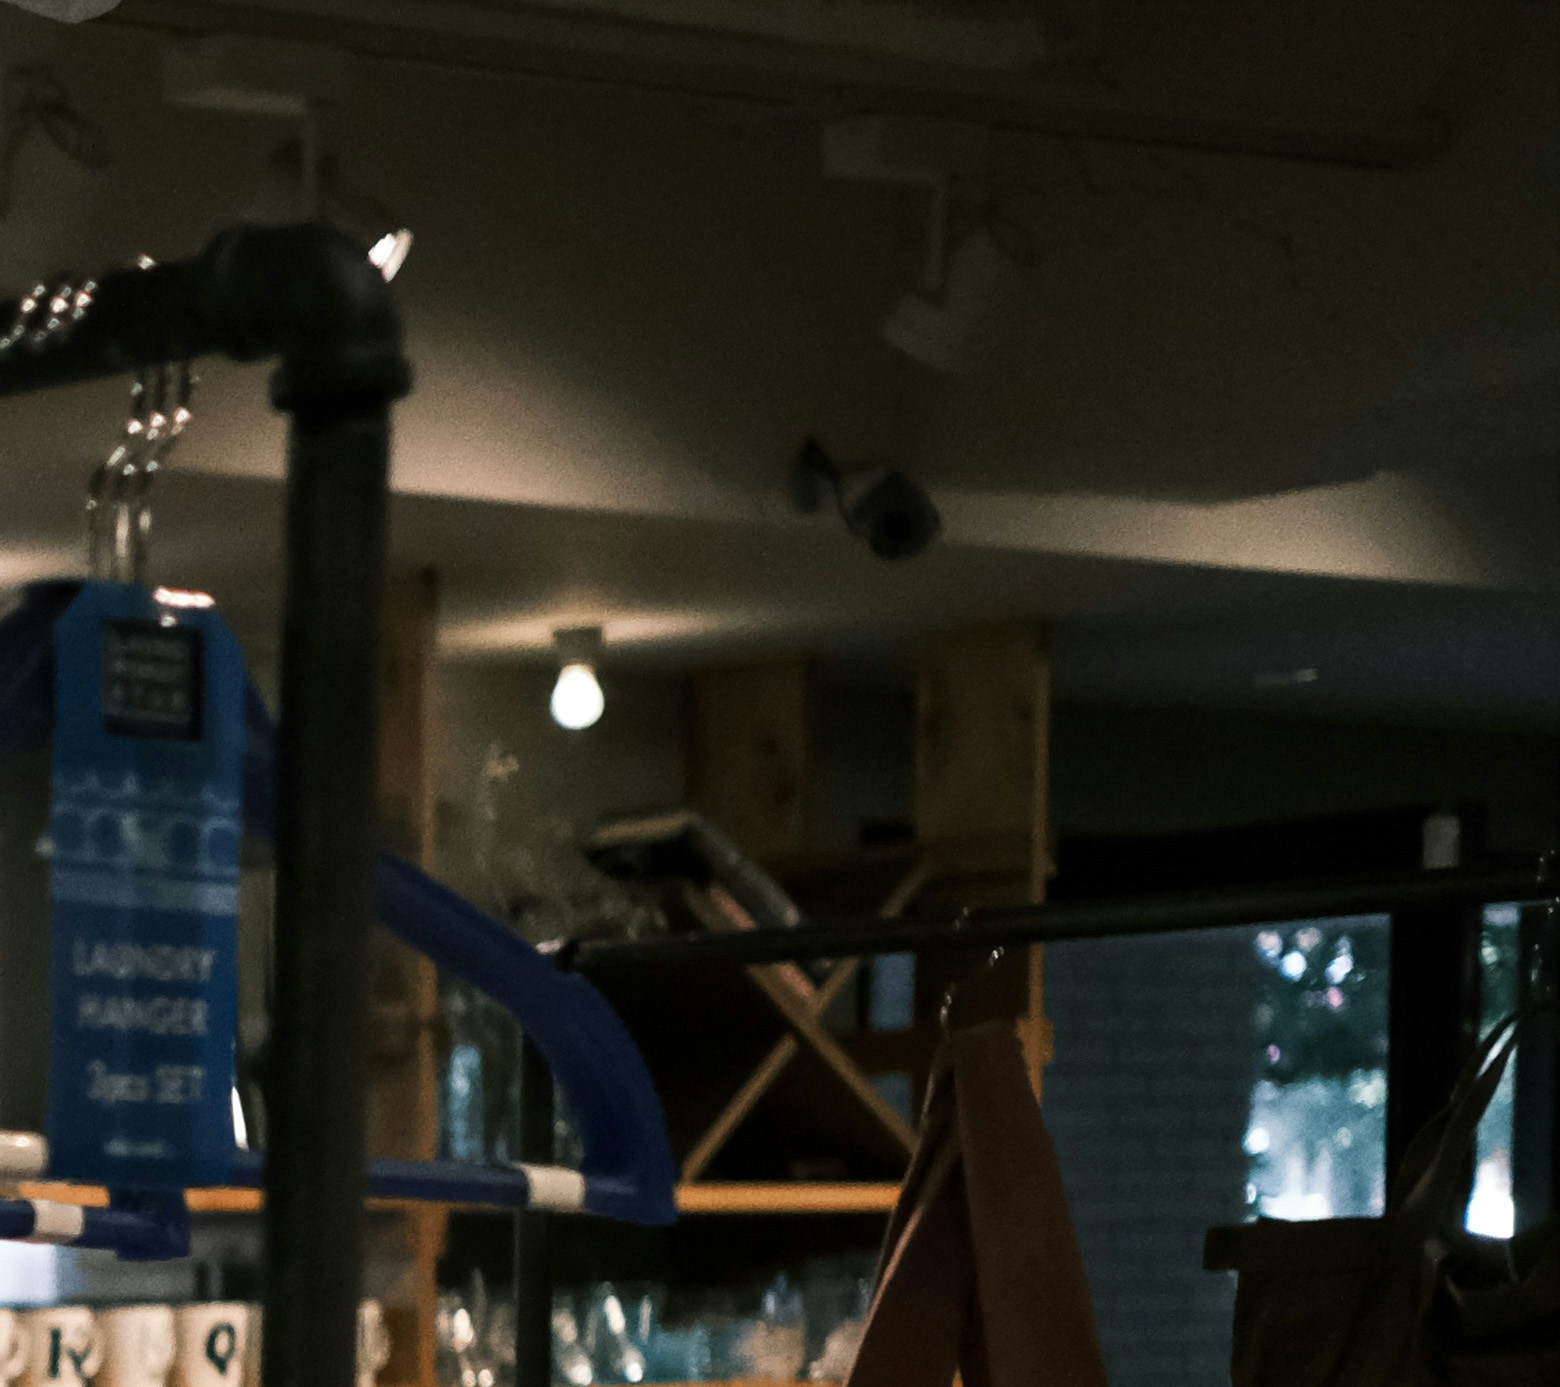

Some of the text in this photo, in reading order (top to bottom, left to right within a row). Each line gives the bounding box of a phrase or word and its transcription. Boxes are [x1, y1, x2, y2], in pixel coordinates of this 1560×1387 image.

[74, 935, 215, 982] LAUNDRY
[78, 990, 208, 1036] HANGER
[154, 1062, 207, 1104] SET
